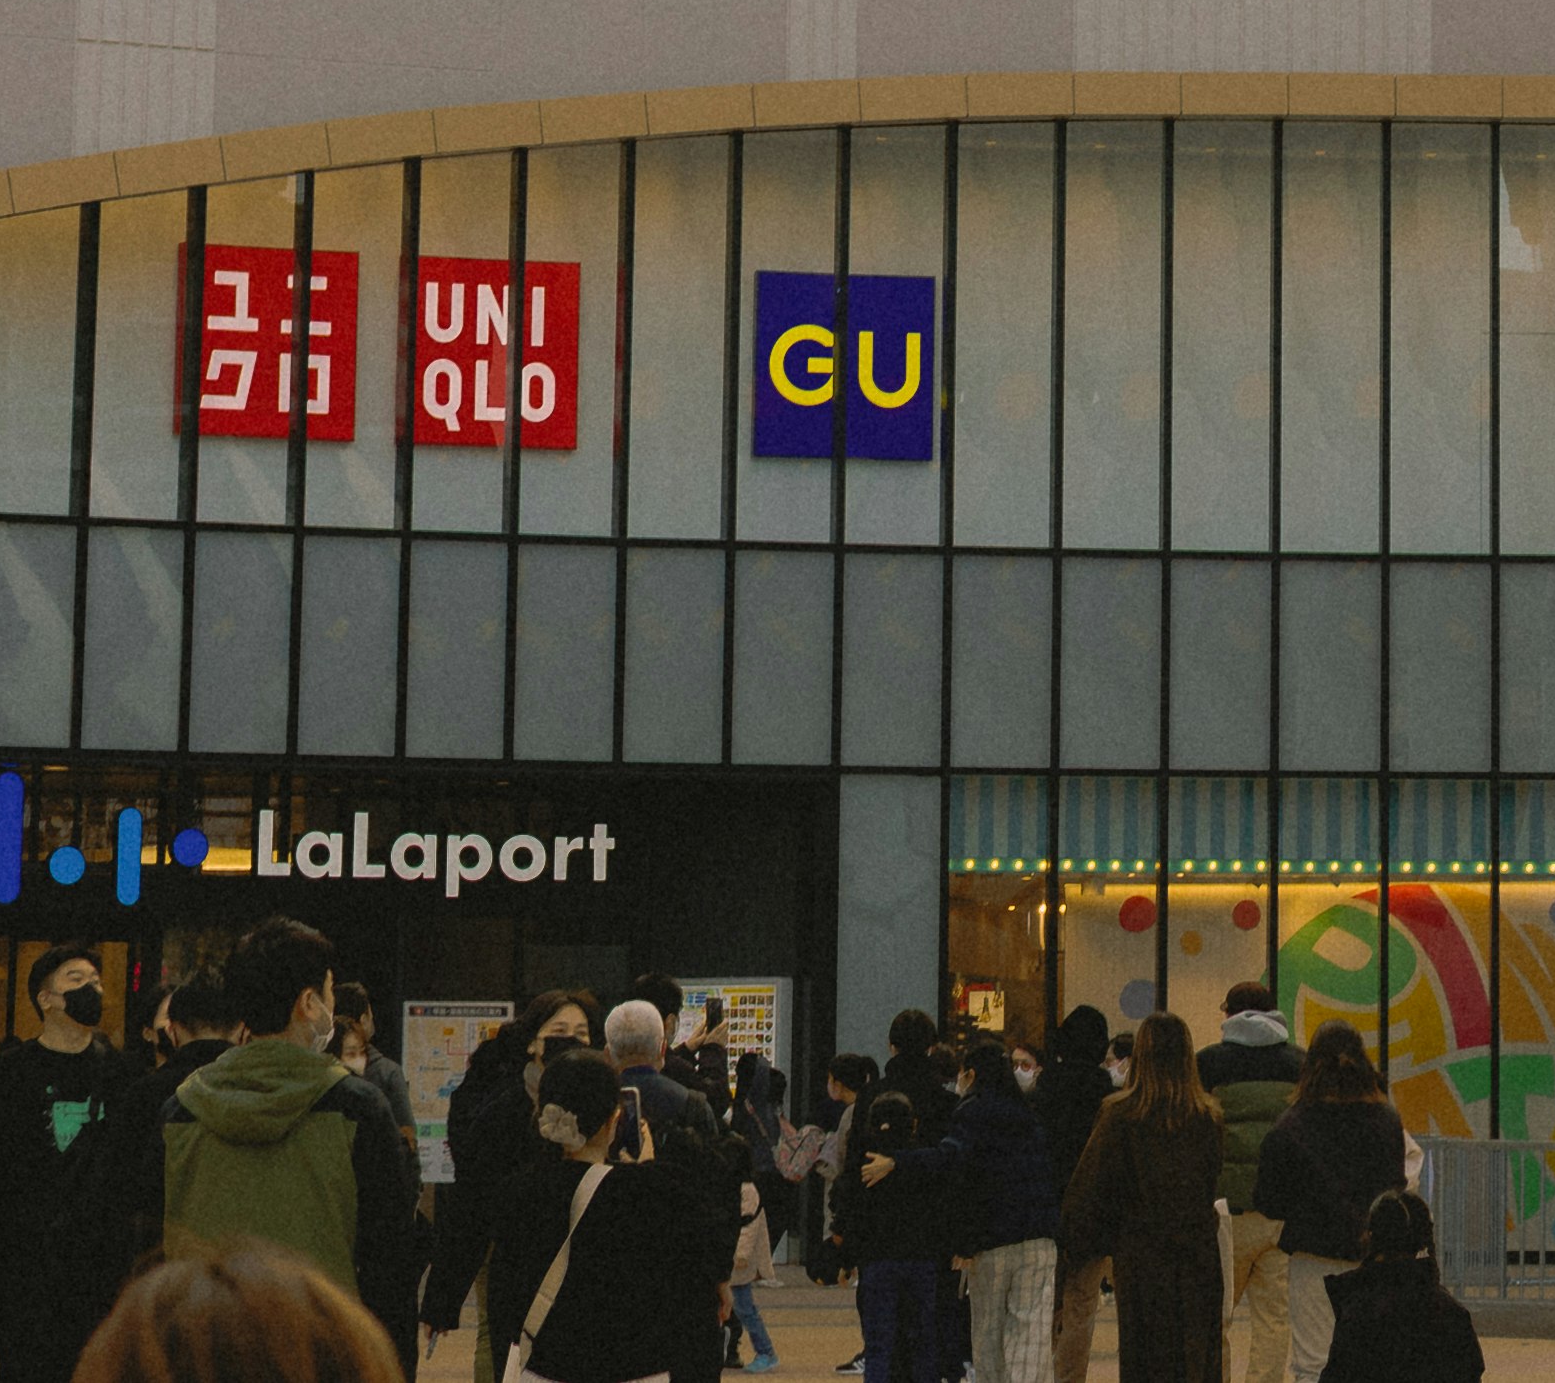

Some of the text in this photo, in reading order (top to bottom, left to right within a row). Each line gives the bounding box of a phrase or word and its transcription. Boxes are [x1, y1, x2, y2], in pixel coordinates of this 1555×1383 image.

[206, 271, 332, 336] ユニ
[424, 281, 545, 348] UNI
[200, 349, 331, 415] クロ
[422, 358, 557, 431] QLO
[769, 323, 921, 409] GU
[256, 808, 616, 898] LaLaport
